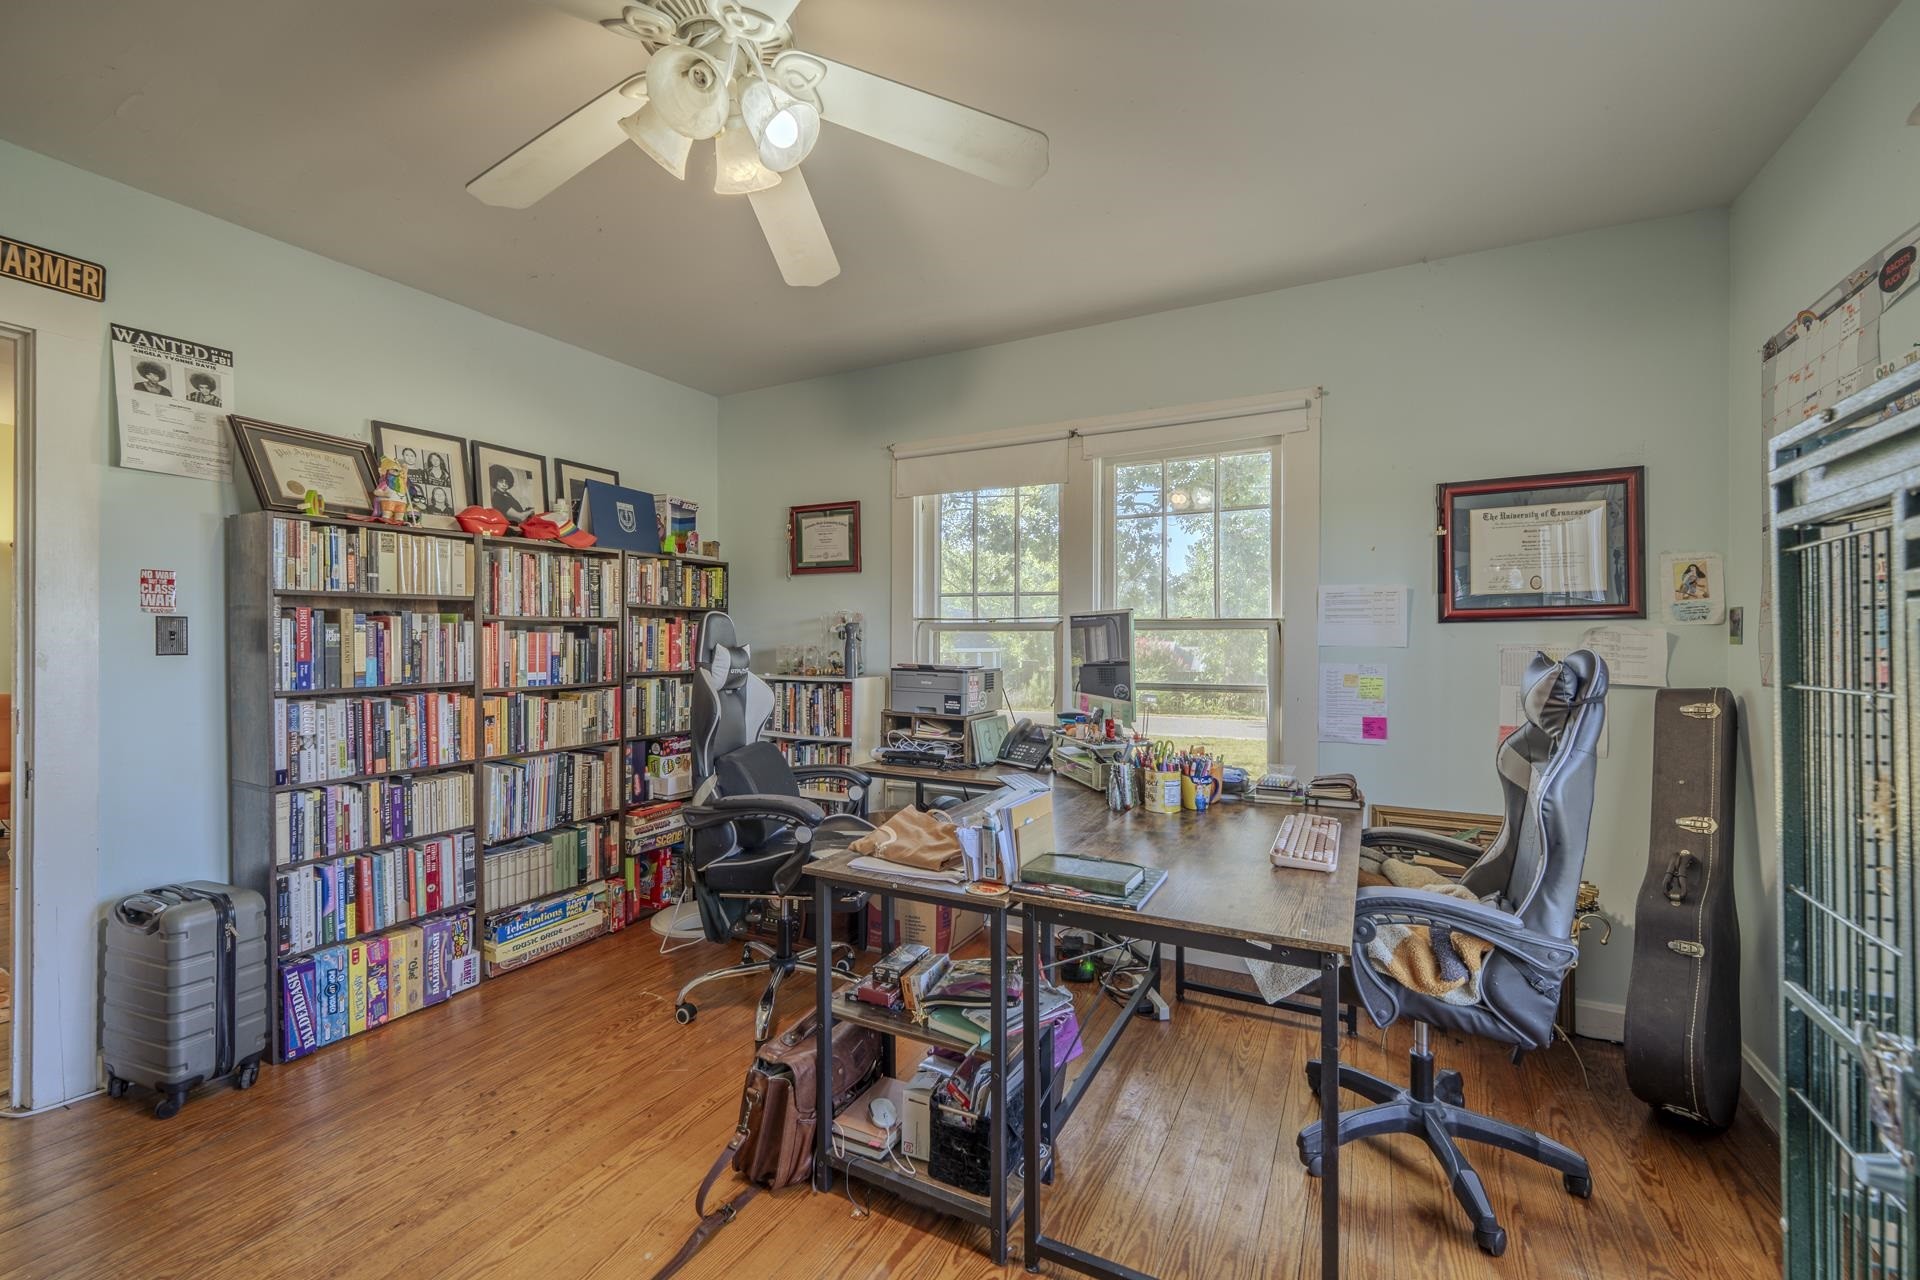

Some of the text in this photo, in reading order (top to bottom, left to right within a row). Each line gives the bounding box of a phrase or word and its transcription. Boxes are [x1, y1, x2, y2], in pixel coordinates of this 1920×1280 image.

[0, 240, 99, 298] ARMER
[111, 326, 209, 360] WANTED
[133, 348, 162, 358] ANGELA
[164, 355, 194, 365] YVONNE
[195, 362, 217, 371] DAVIS
[211, 355, 231, 366] FBI
[1482, 507, 1592, 522] The University of Tennessee
[299, 609, 308, 642] BRITAIN
[347, 874, 355, 894] Algebra
[505, 908, 563, 936] Telestrations
[432, 931, 441, 995] BALDERDASH
[463, 958, 472, 985] MEME?
[286, 970, 316, 1050] BALDERDASH
